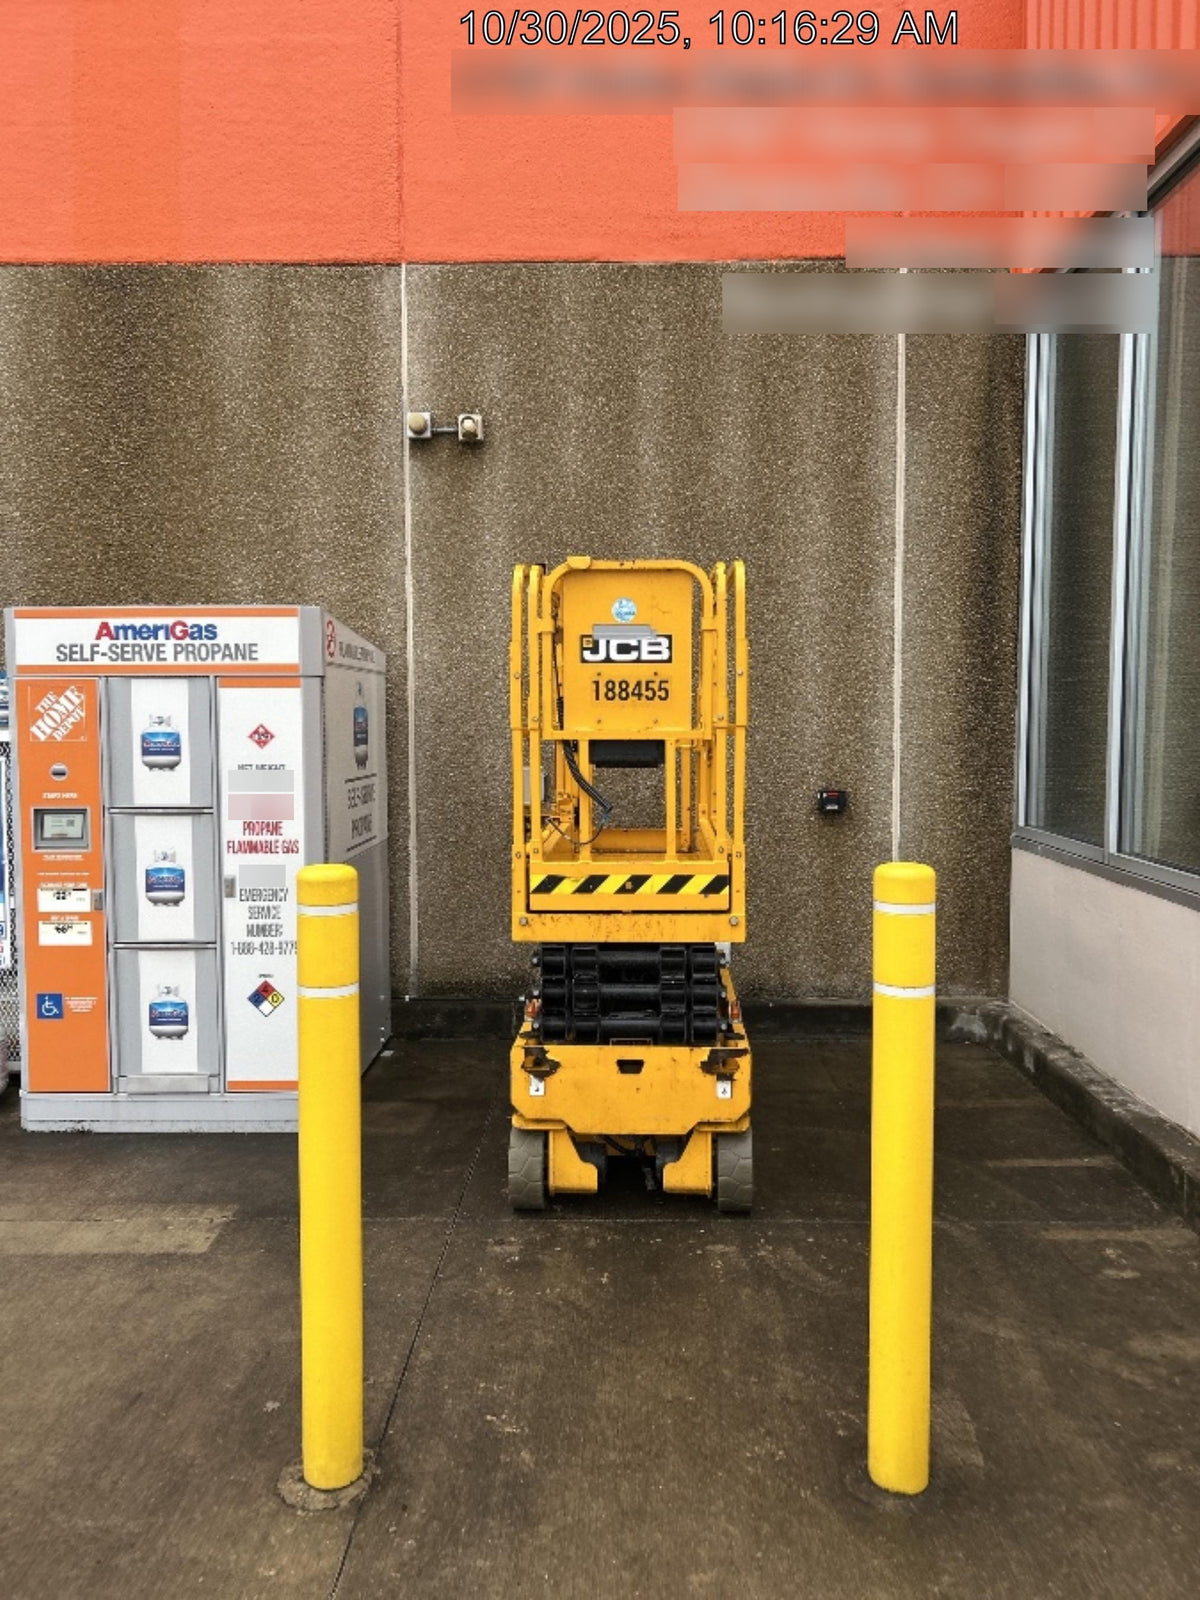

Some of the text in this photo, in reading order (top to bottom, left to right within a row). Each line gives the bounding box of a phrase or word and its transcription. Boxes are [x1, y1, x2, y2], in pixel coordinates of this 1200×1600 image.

[95, 620, 218, 640] AmeriGas
[56, 643, 259, 662] SELF-SERVE PROPANE
[583, 636, 670, 661] JCB
[592, 680, 669, 701] 188455
[35, 691, 58, 714] THE
[30, 686, 84, 741] HOME
[52, 705, 85, 741] DEPOT
[242, 821, 283, 836] PROPANE
[227, 840, 299, 854] FLAMMABLE GAS
[239, 888, 289, 902] EMERGENCY
[248, 905, 281, 919] SERVICE
